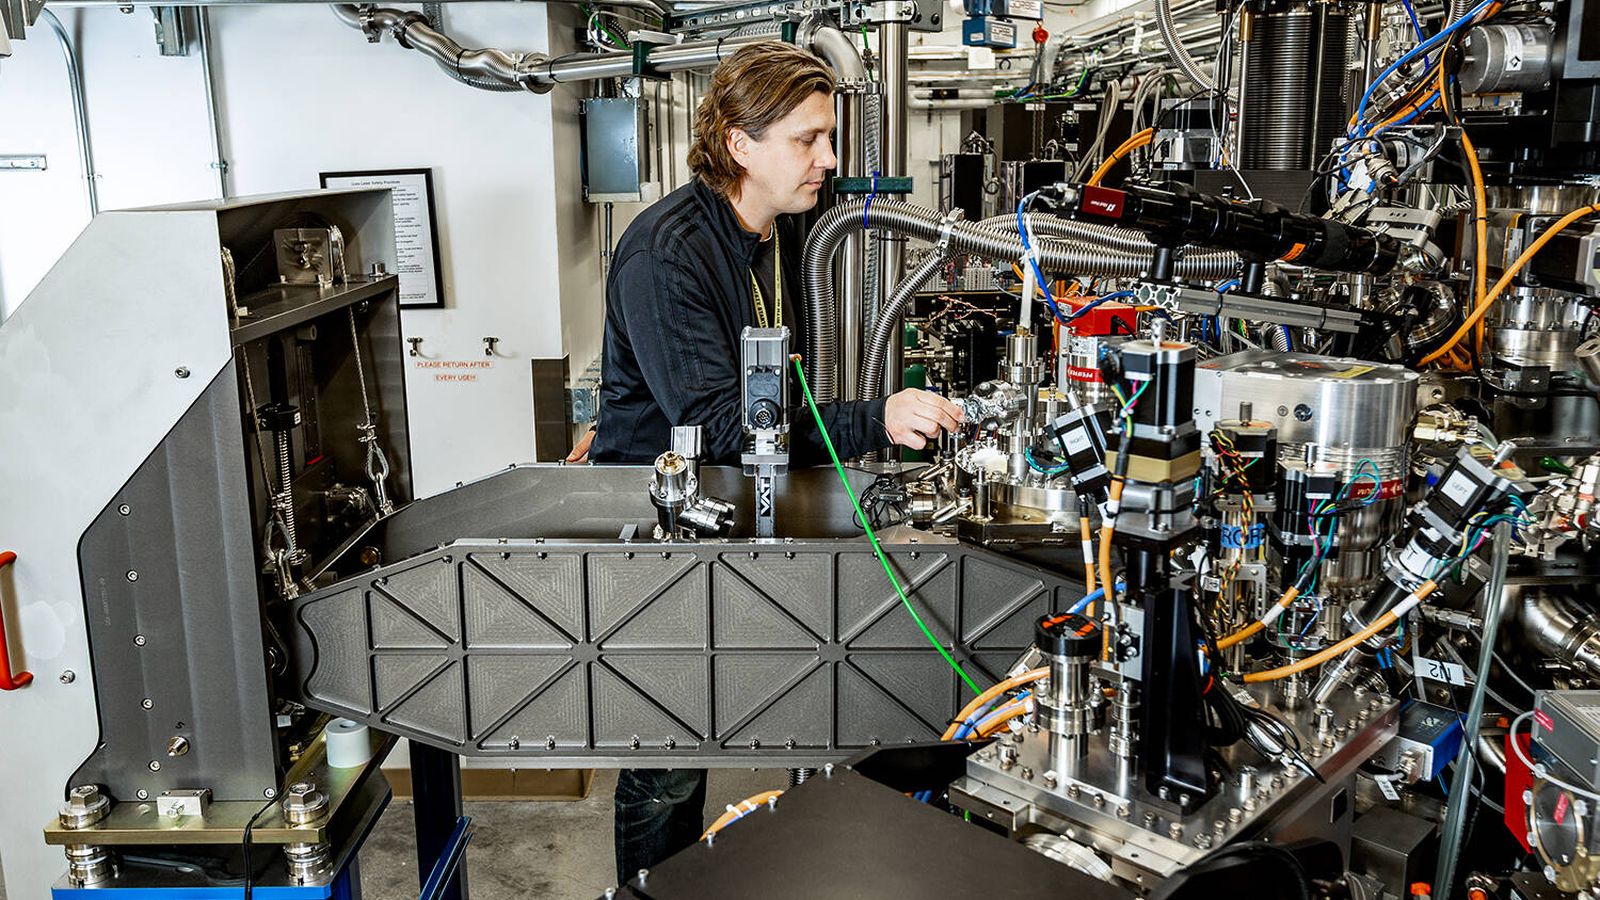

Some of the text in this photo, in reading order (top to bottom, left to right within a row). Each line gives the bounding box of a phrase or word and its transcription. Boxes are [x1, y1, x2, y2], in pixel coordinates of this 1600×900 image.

[469, 360, 491, 368] AFTER
[1451, 481, 1469, 496] LEFT
[760, 478, 770, 516] VAT
